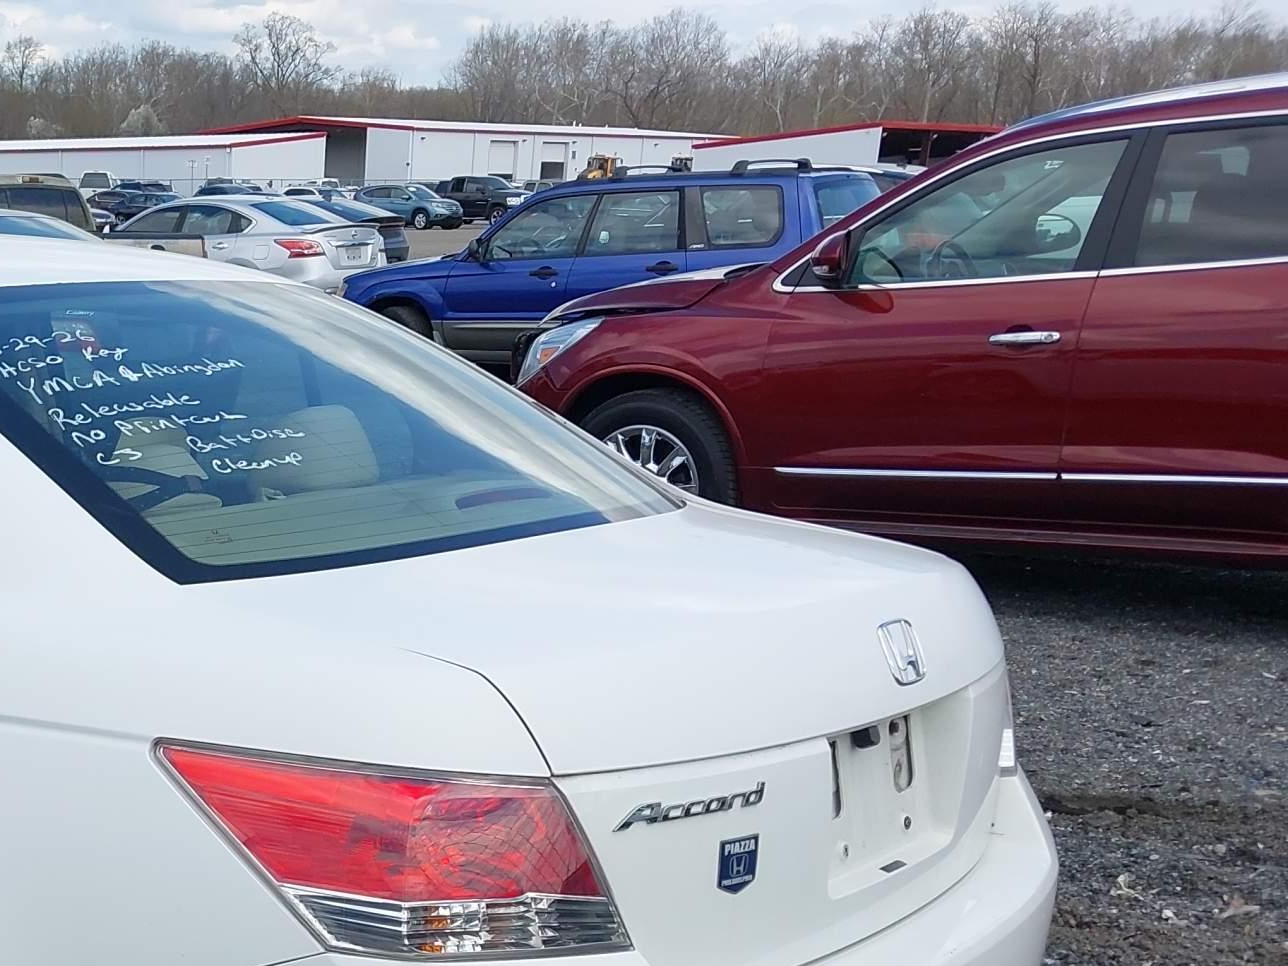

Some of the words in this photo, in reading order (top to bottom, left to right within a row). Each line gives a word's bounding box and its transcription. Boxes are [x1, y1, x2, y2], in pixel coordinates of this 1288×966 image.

[82, 346, 129, 361] Key
[17, 371, 120, 404] YMCA
[612, 781, 766, 832] Accord
[724, 838, 756, 857] PIAZZA
